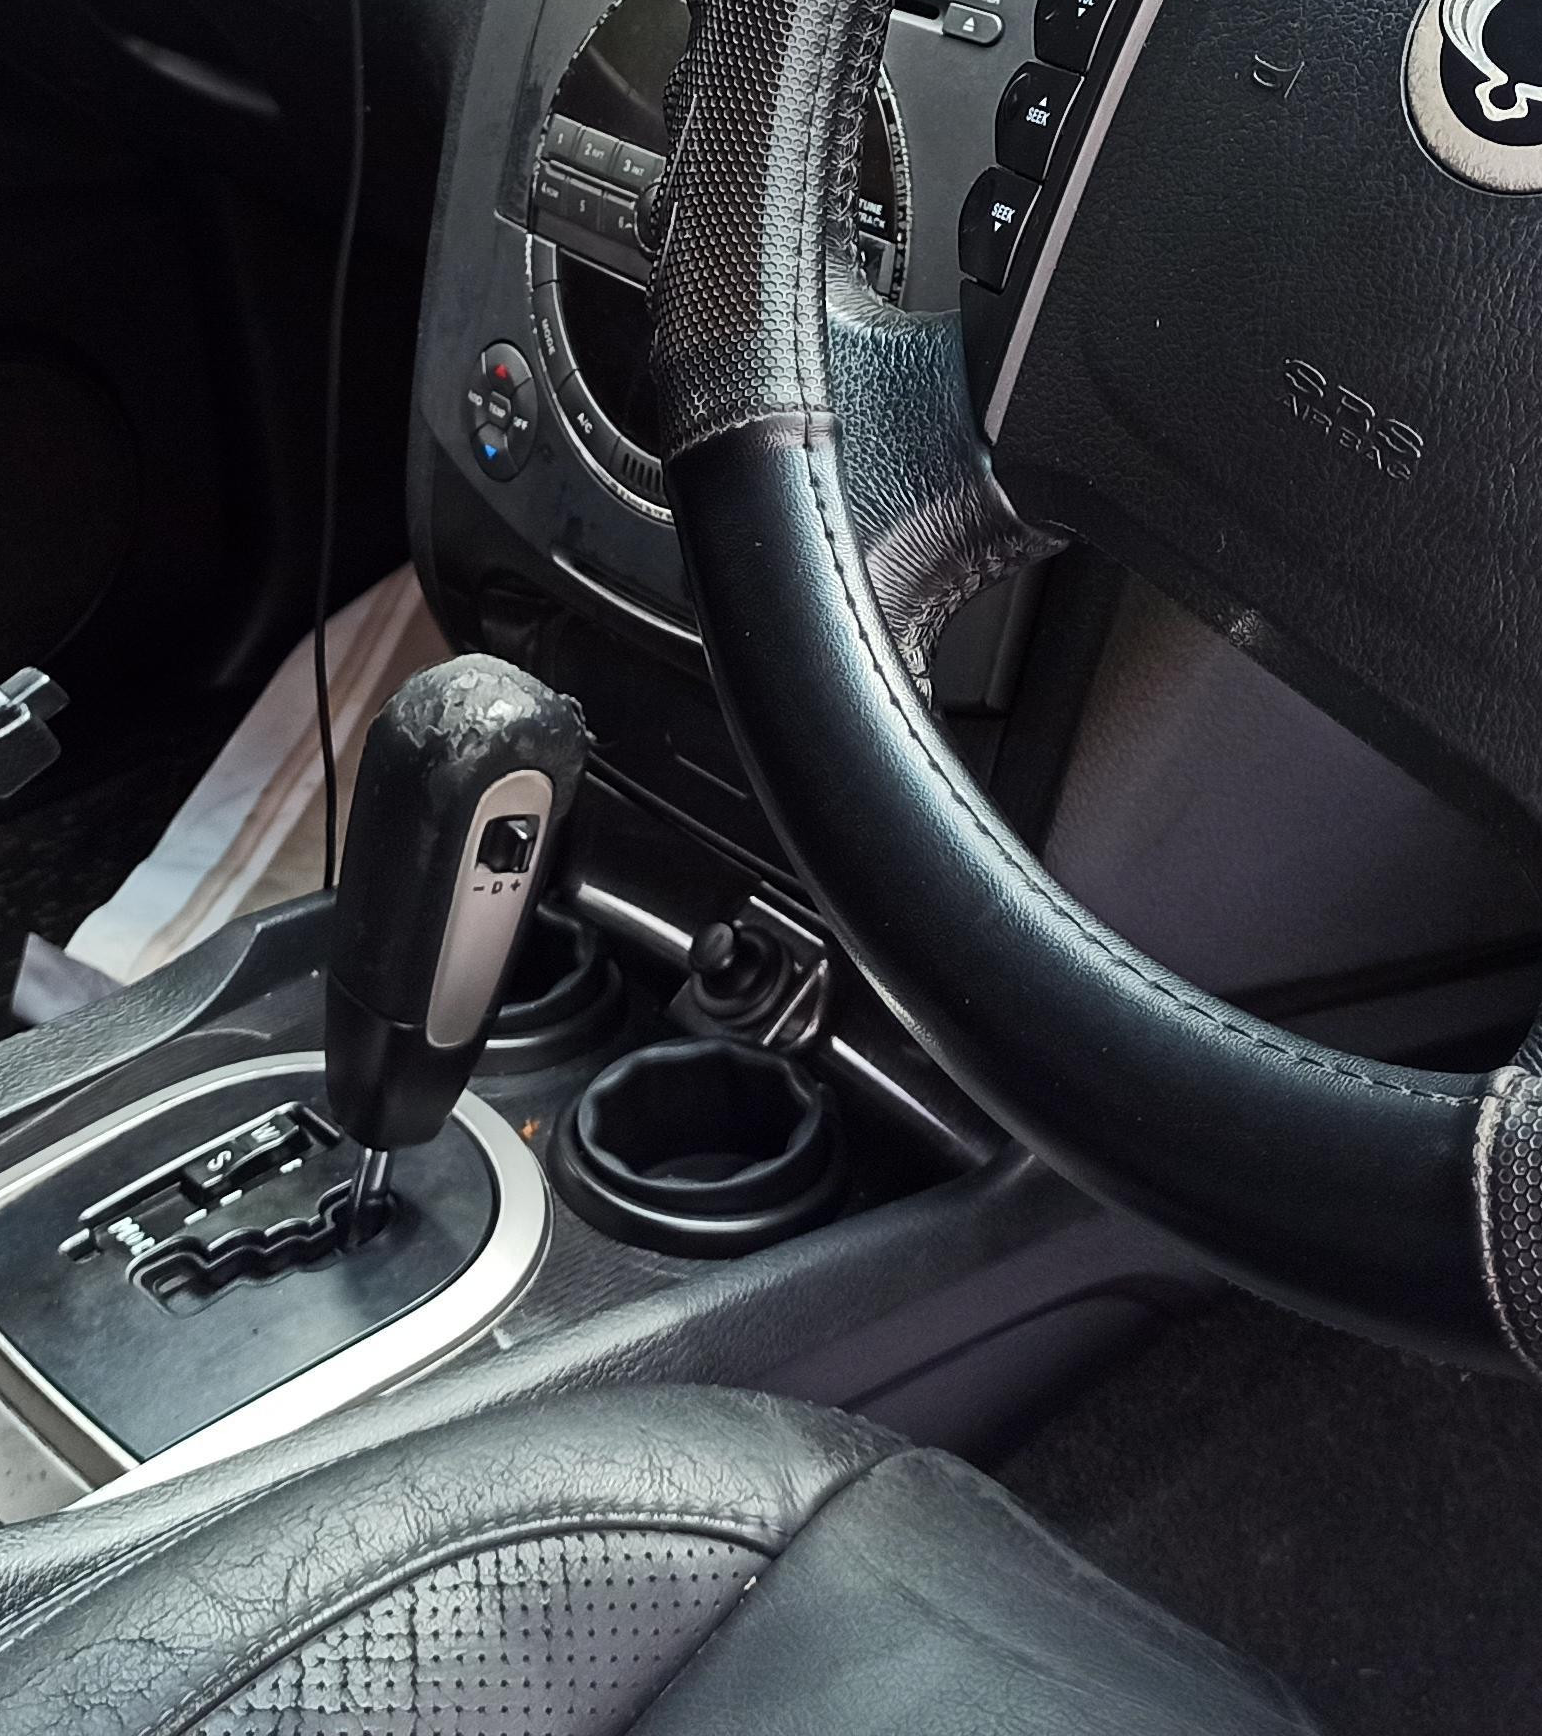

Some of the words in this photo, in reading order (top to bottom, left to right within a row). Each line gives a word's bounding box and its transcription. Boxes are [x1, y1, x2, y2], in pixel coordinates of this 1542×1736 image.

[1025, 106, 1052, 127] SEEK
[990, 202, 1017, 225] SEEK
[1282, 357, 1425, 459] SRS
[207, 1149, 233, 1172] S
